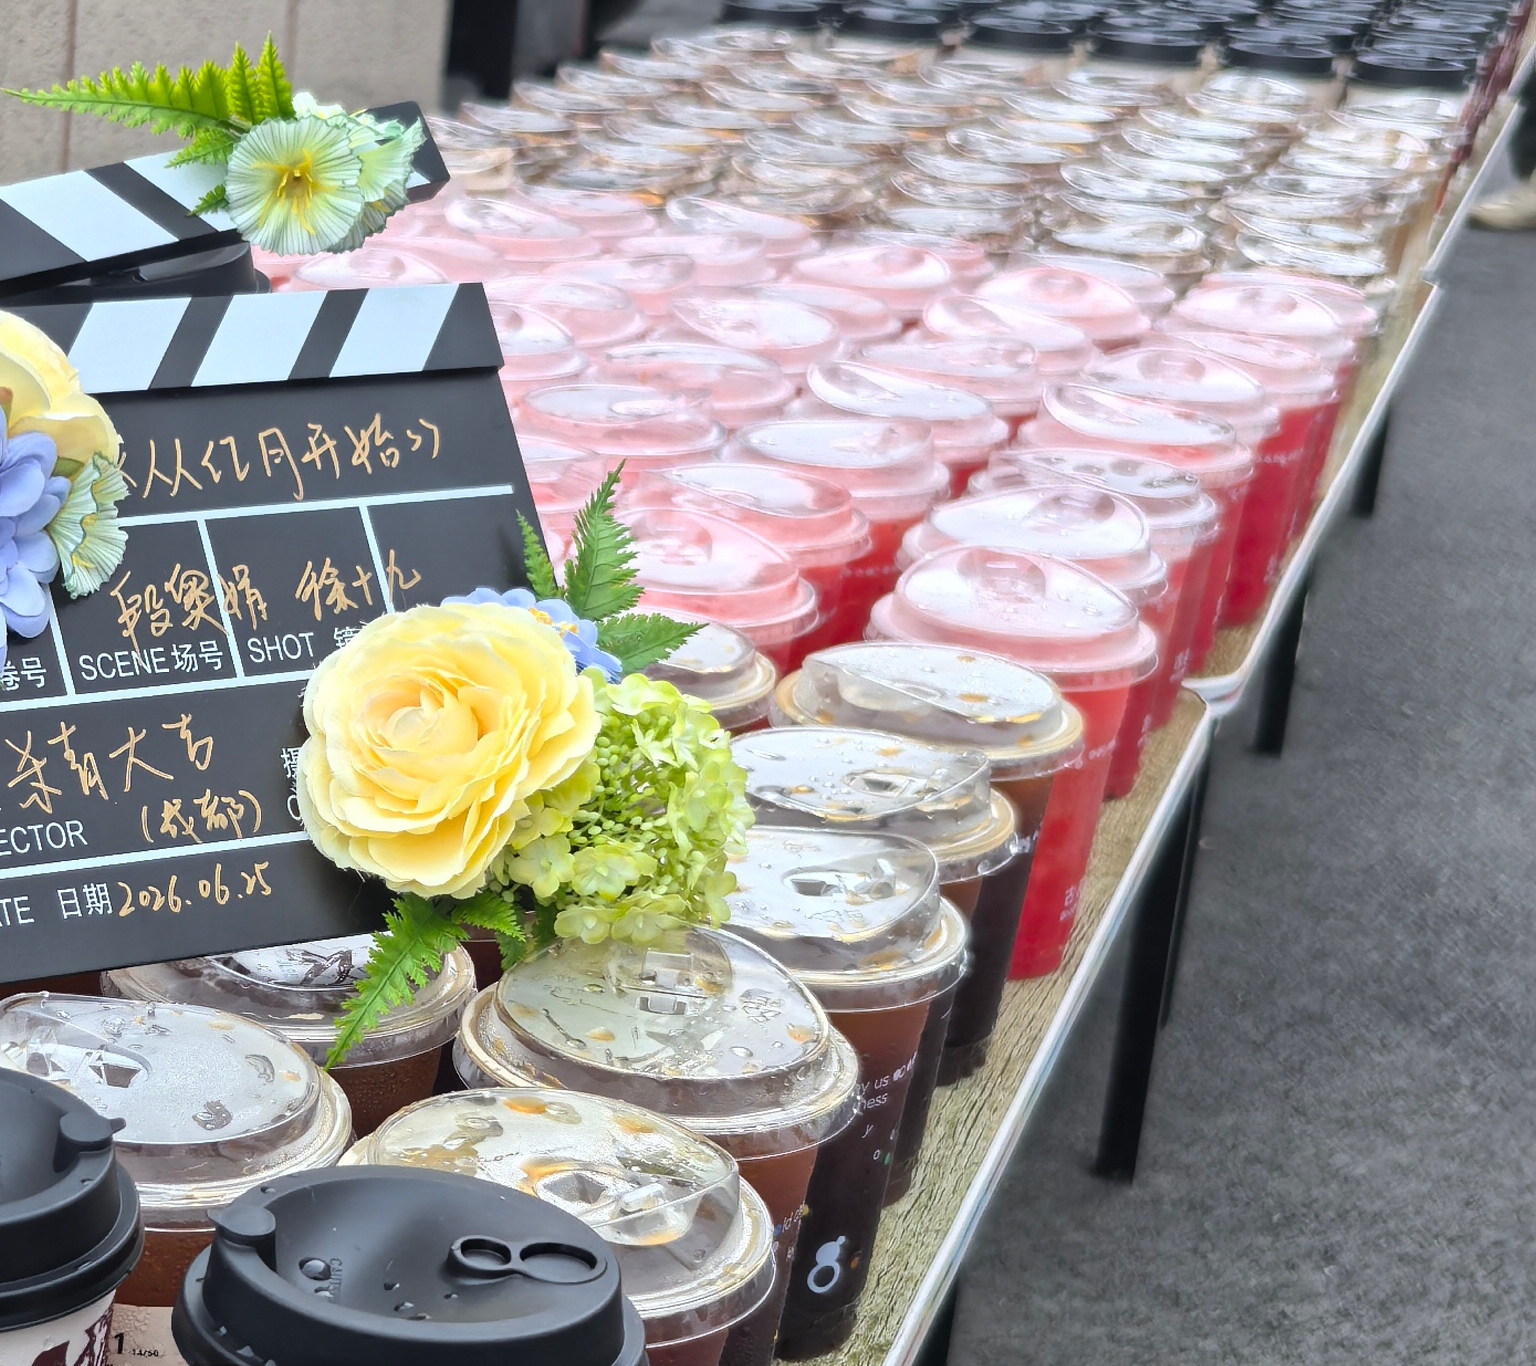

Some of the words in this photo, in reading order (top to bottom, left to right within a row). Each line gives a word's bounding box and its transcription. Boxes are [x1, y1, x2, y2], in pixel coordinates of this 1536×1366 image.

[78, 647, 170, 681] SCENE
[171, 640, 224, 673] 场号
[247, 631, 315, 663] SHOT
[56, 881, 114, 920] 日期
